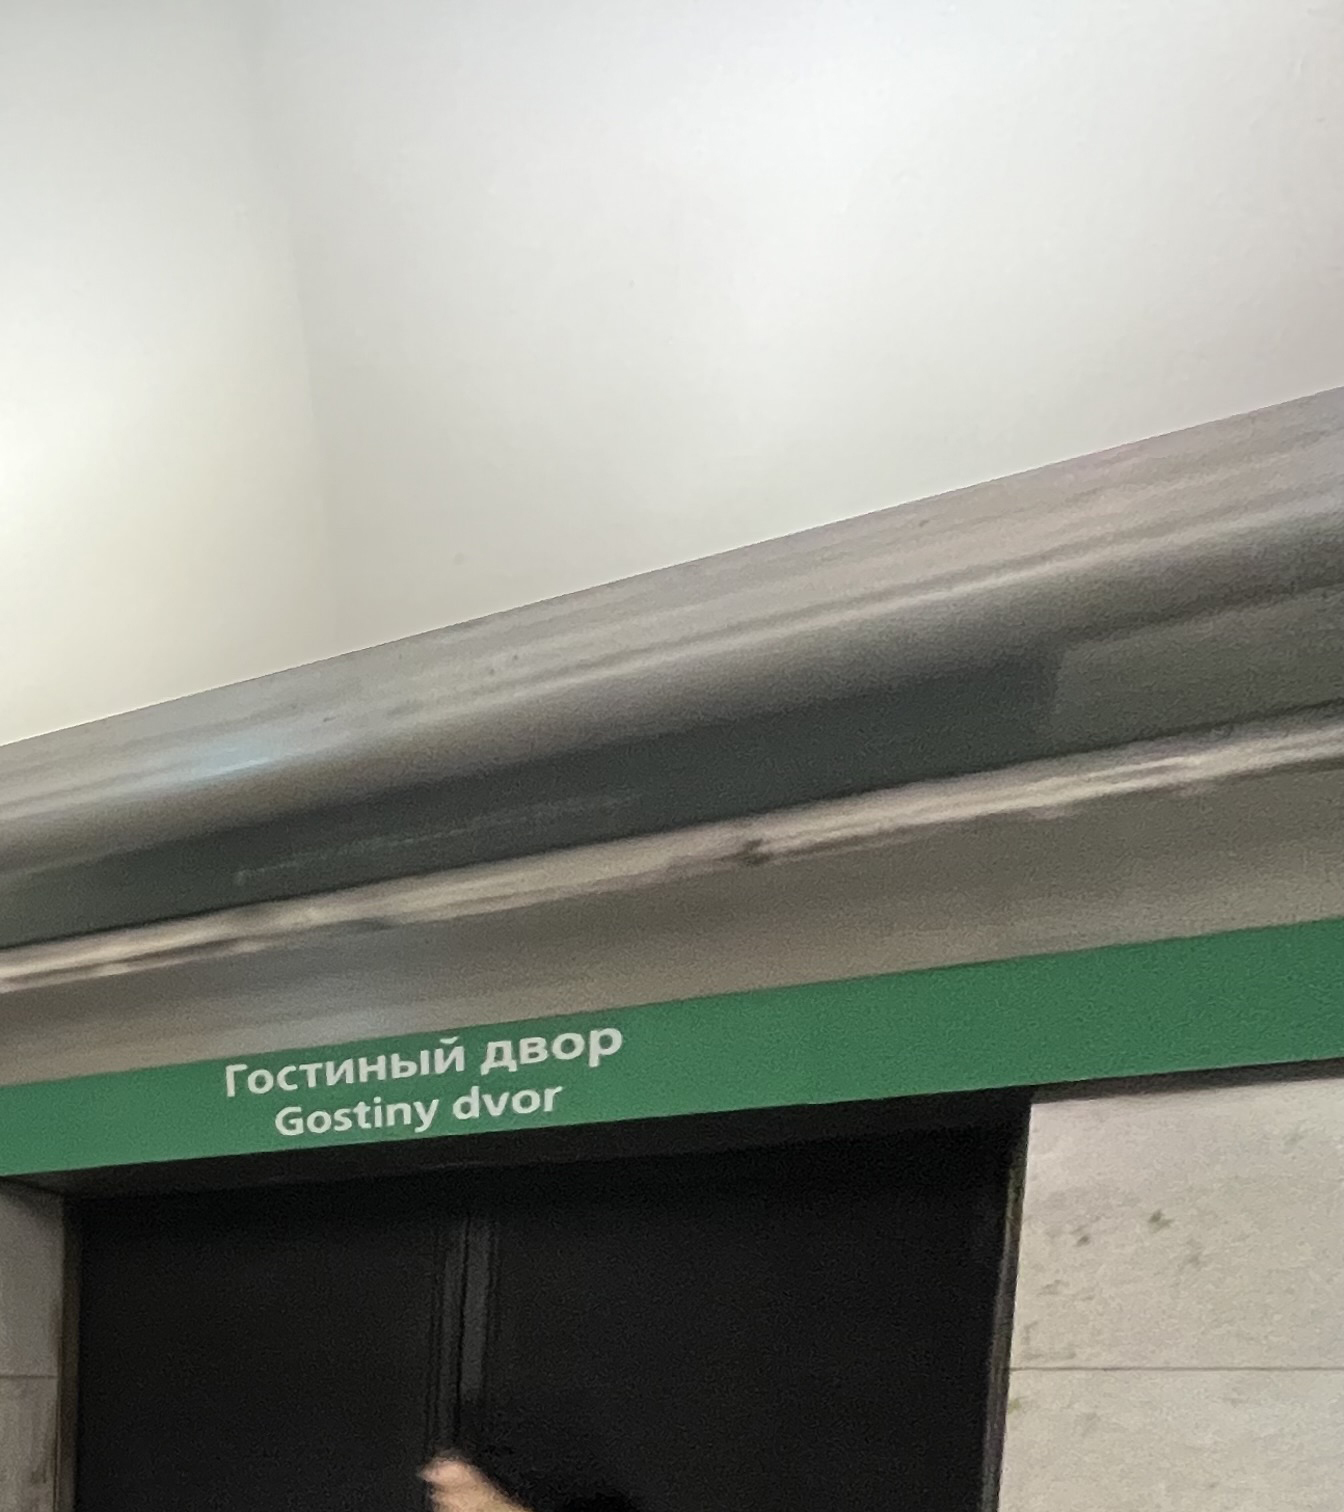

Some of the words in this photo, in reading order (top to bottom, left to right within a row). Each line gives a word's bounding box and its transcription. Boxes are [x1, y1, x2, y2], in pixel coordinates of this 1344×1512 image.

[224, 1036, 466, 1098] Гостиный
[480, 1027, 623, 1076] двор
[274, 1096, 440, 1138] Gostiny
[452, 1086, 564, 1121] dvor
